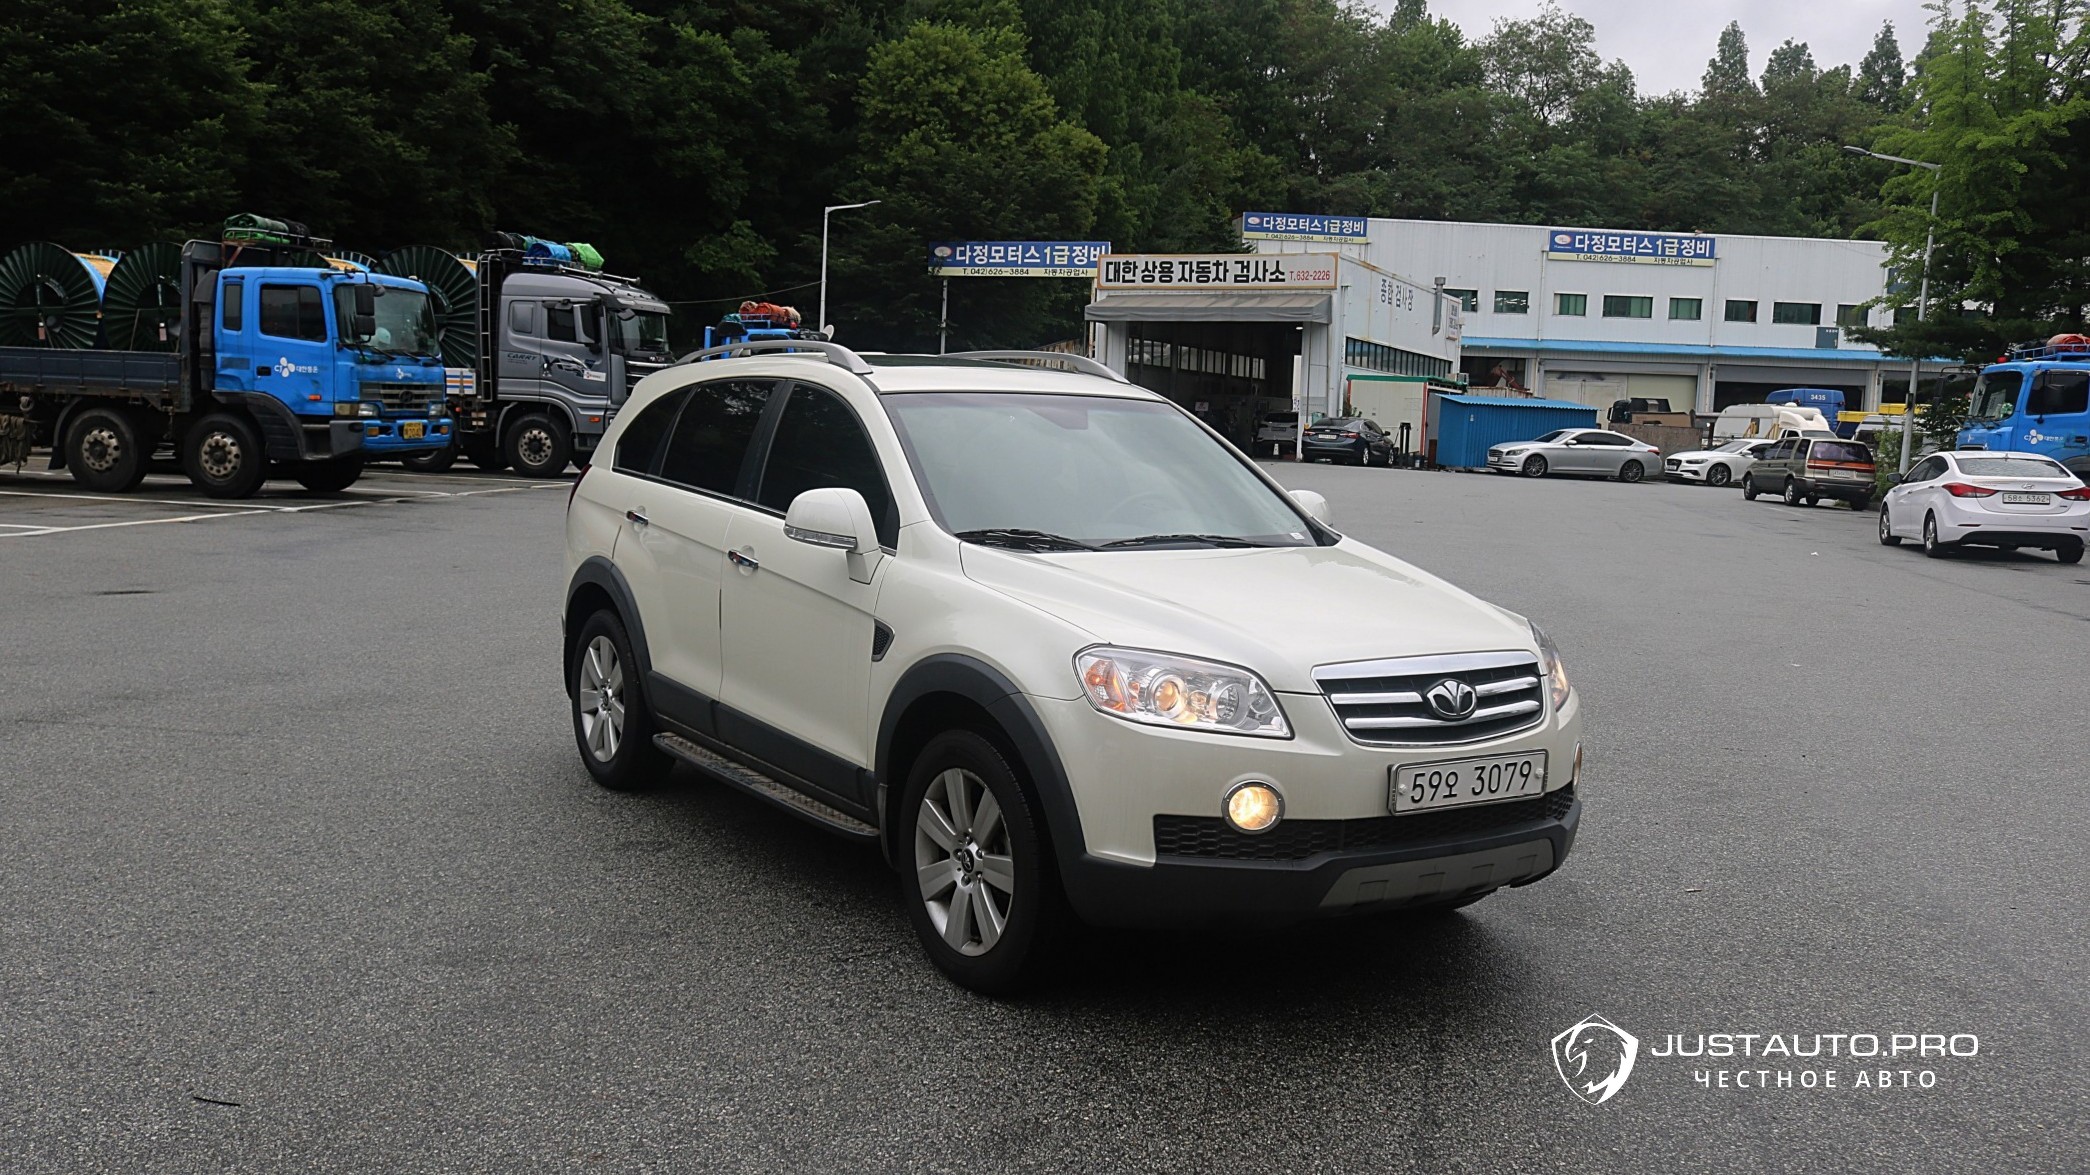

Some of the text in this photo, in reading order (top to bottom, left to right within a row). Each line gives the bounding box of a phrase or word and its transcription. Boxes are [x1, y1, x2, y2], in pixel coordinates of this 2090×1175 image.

[1043, 268, 1088, 277] 자동차공업사
[1105, 261, 1138, 283] 대한
[1140, 261, 1174, 284] 상용
[1177, 260, 1229, 283] 자동차
[1233, 260, 1286, 284] 검사소
[1380, 278, 1414, 312] 종합 검사장
[2026, 494, 2046, 502] 5362
[1410, 760, 1532, 804] 59오 3079
